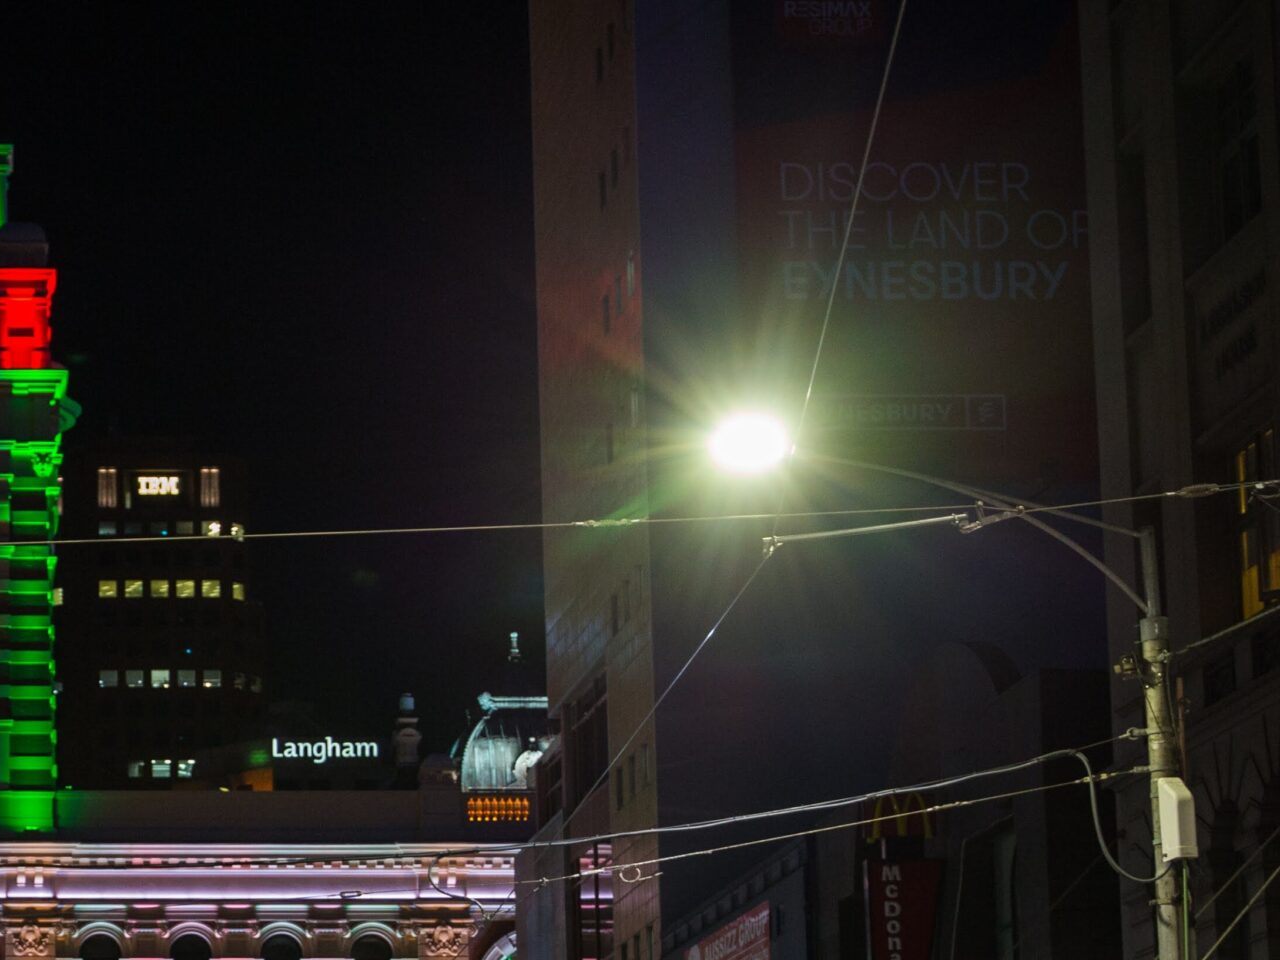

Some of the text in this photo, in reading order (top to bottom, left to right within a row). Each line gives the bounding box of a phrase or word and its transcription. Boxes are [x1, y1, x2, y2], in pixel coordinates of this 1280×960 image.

[779, 162, 1031, 201] DISCOVER
[777, 210, 867, 249] THE
[886, 210, 1010, 249] LAND
[782, 260, 1069, 301] EYNESBURY
[138, 476, 179, 495] IBM
[272, 736, 379, 764] Langham
[738, 910, 770, 947] GROUP
